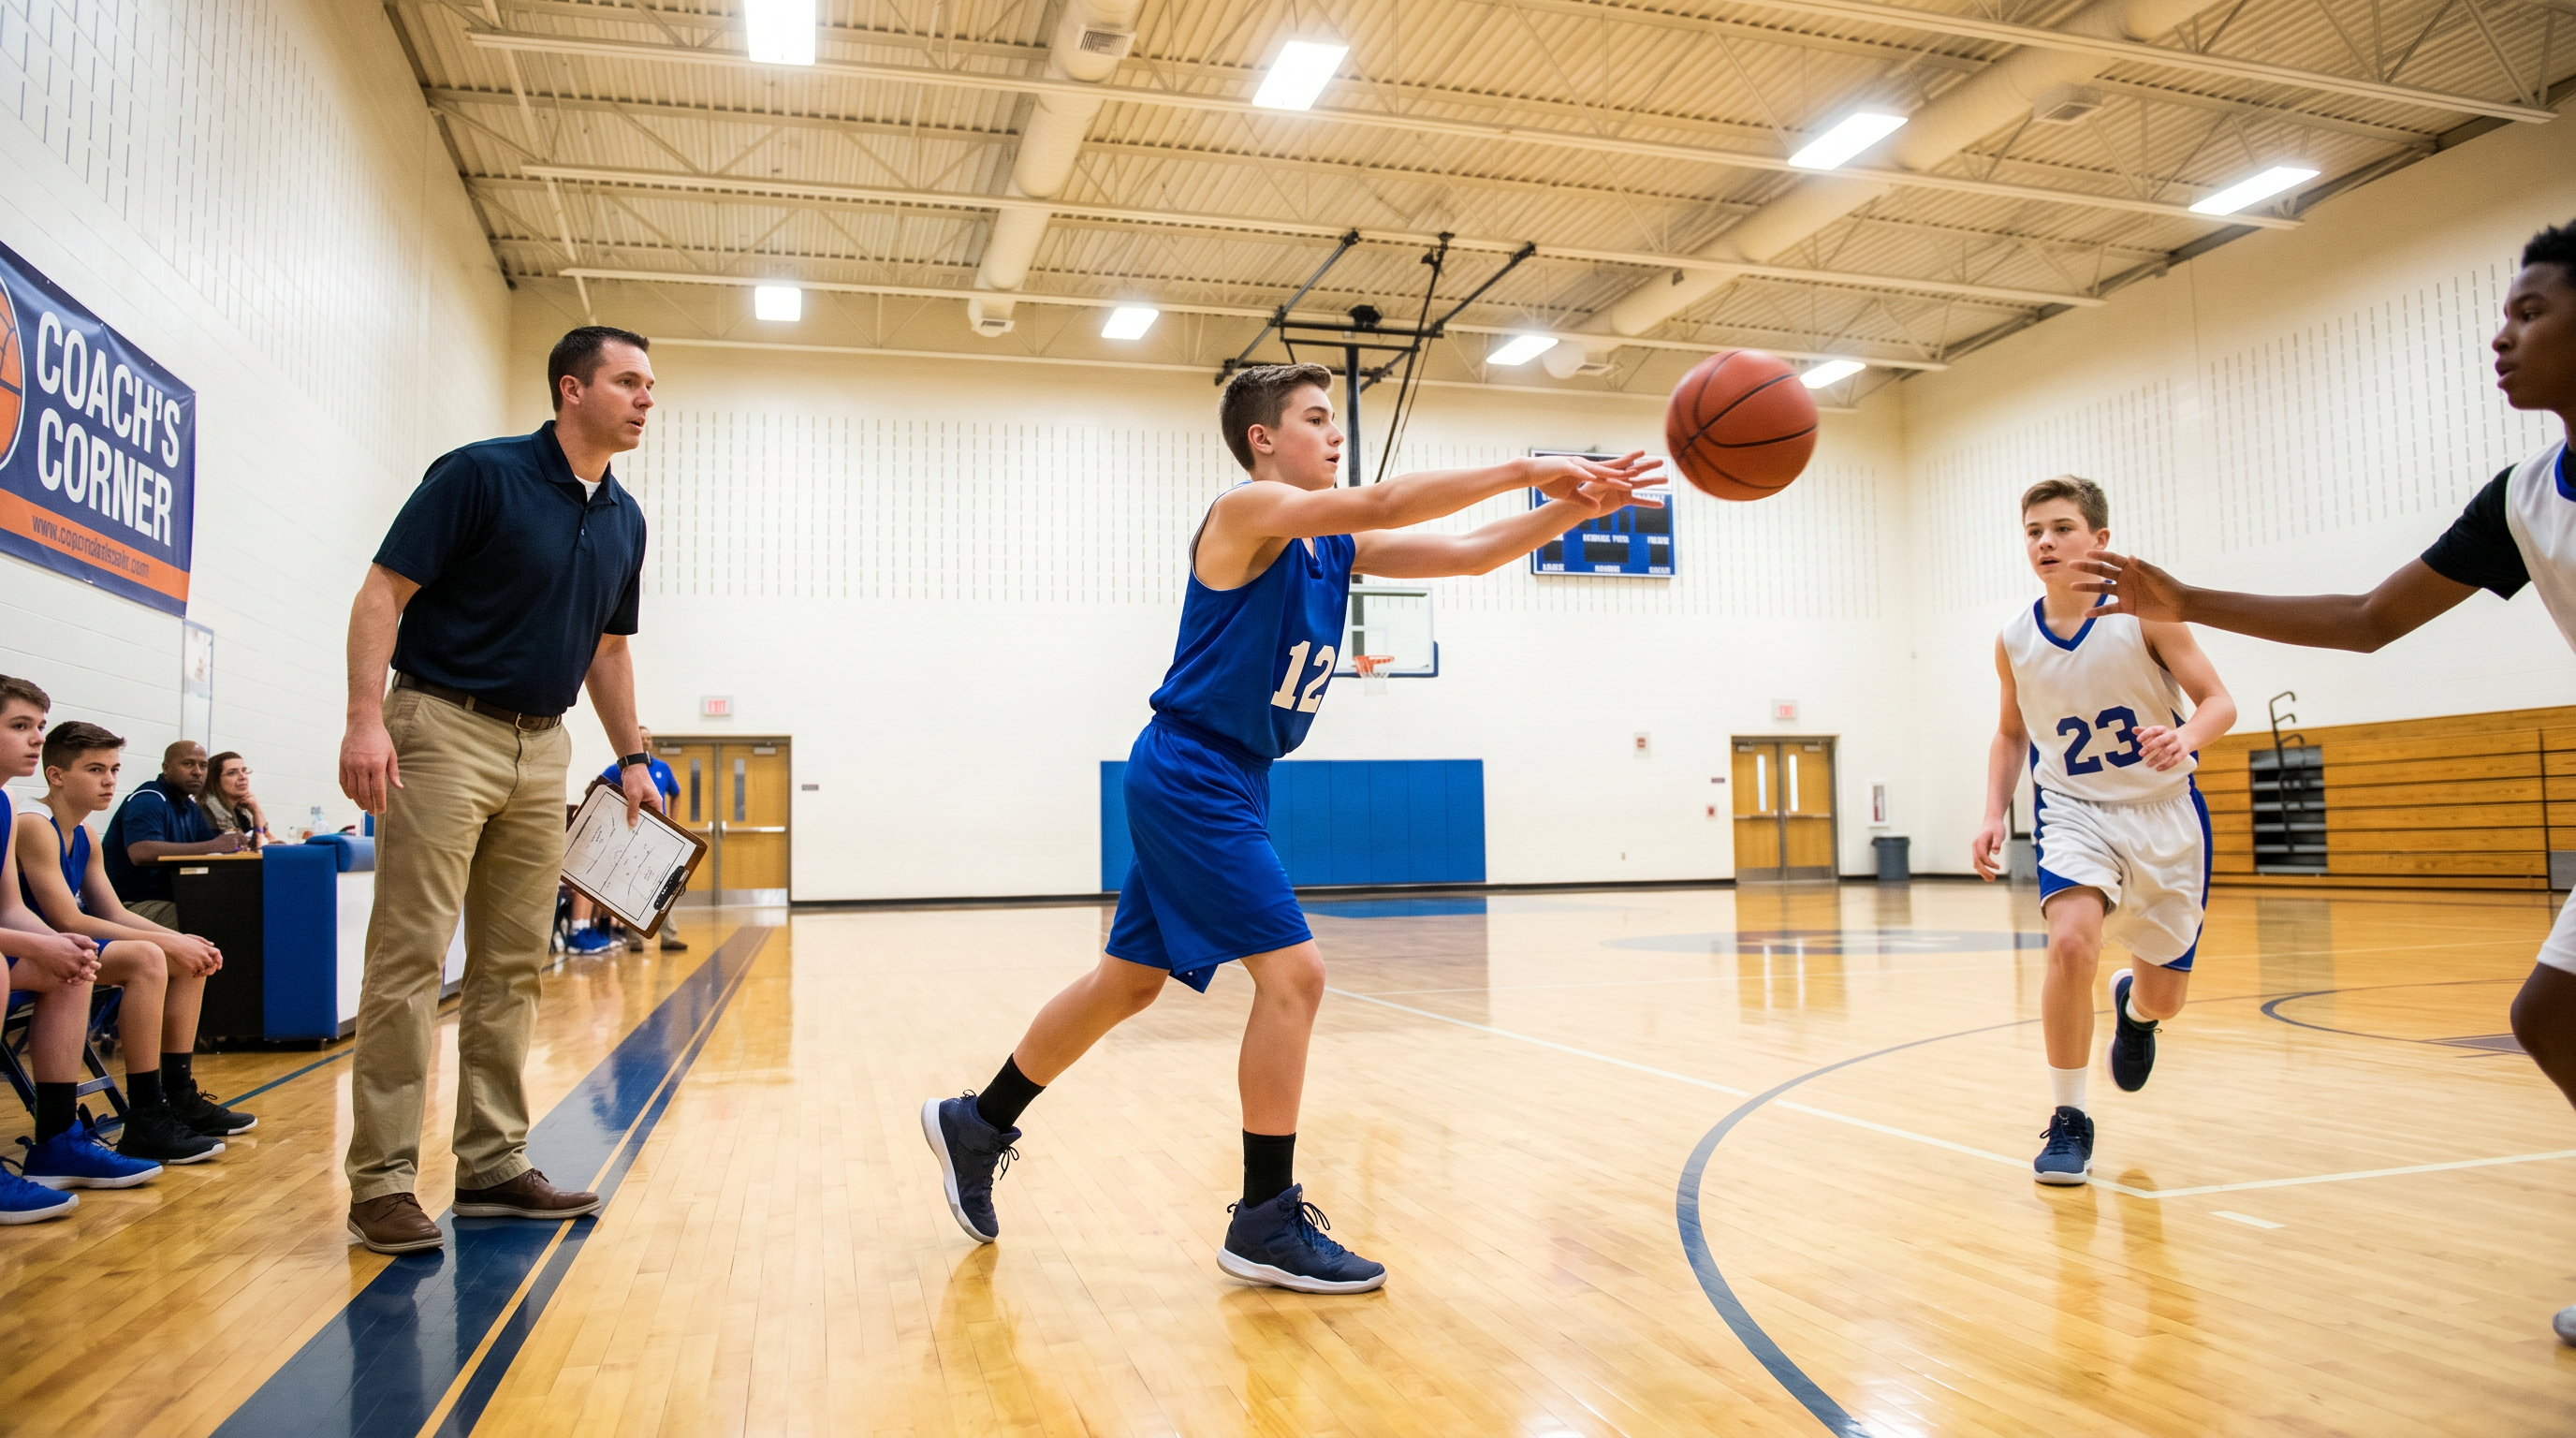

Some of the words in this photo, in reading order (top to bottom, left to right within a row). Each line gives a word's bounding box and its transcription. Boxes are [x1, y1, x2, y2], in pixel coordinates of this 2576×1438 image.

[37, 312, 181, 468] COACH'S
[37, 408, 172, 547] CORNER
[1271, 640, 1337, 713] 12
[2056, 706, 2144, 776] 23
